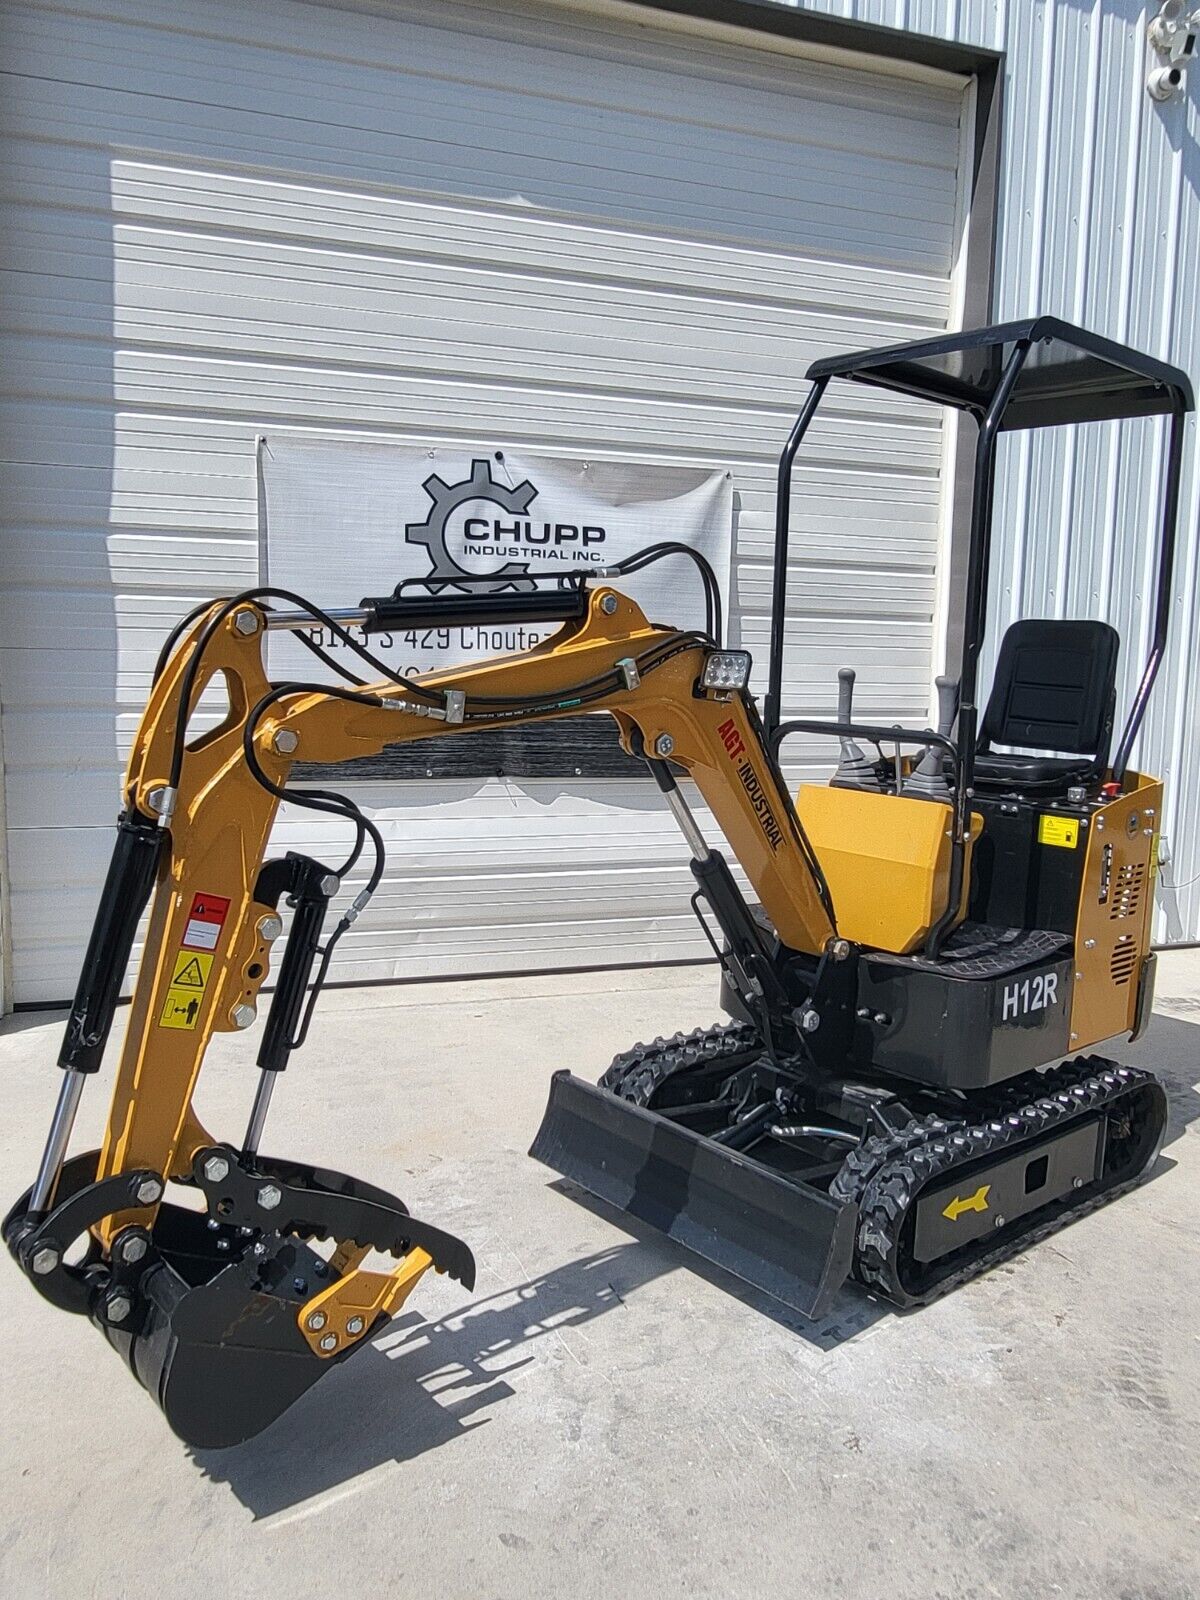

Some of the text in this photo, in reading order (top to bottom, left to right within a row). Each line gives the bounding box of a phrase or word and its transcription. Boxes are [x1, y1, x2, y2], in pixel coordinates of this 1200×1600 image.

[464, 518, 606, 547] CHUPP
[464, 545, 605, 562] INDUSTRIAL INC.
[403, 628, 450, 650] 429
[460, 626, 552, 651] Choute
[717, 718, 784, 852] AGT INDUSTRIAL
[1002, 972, 1058, 1021] H12R
